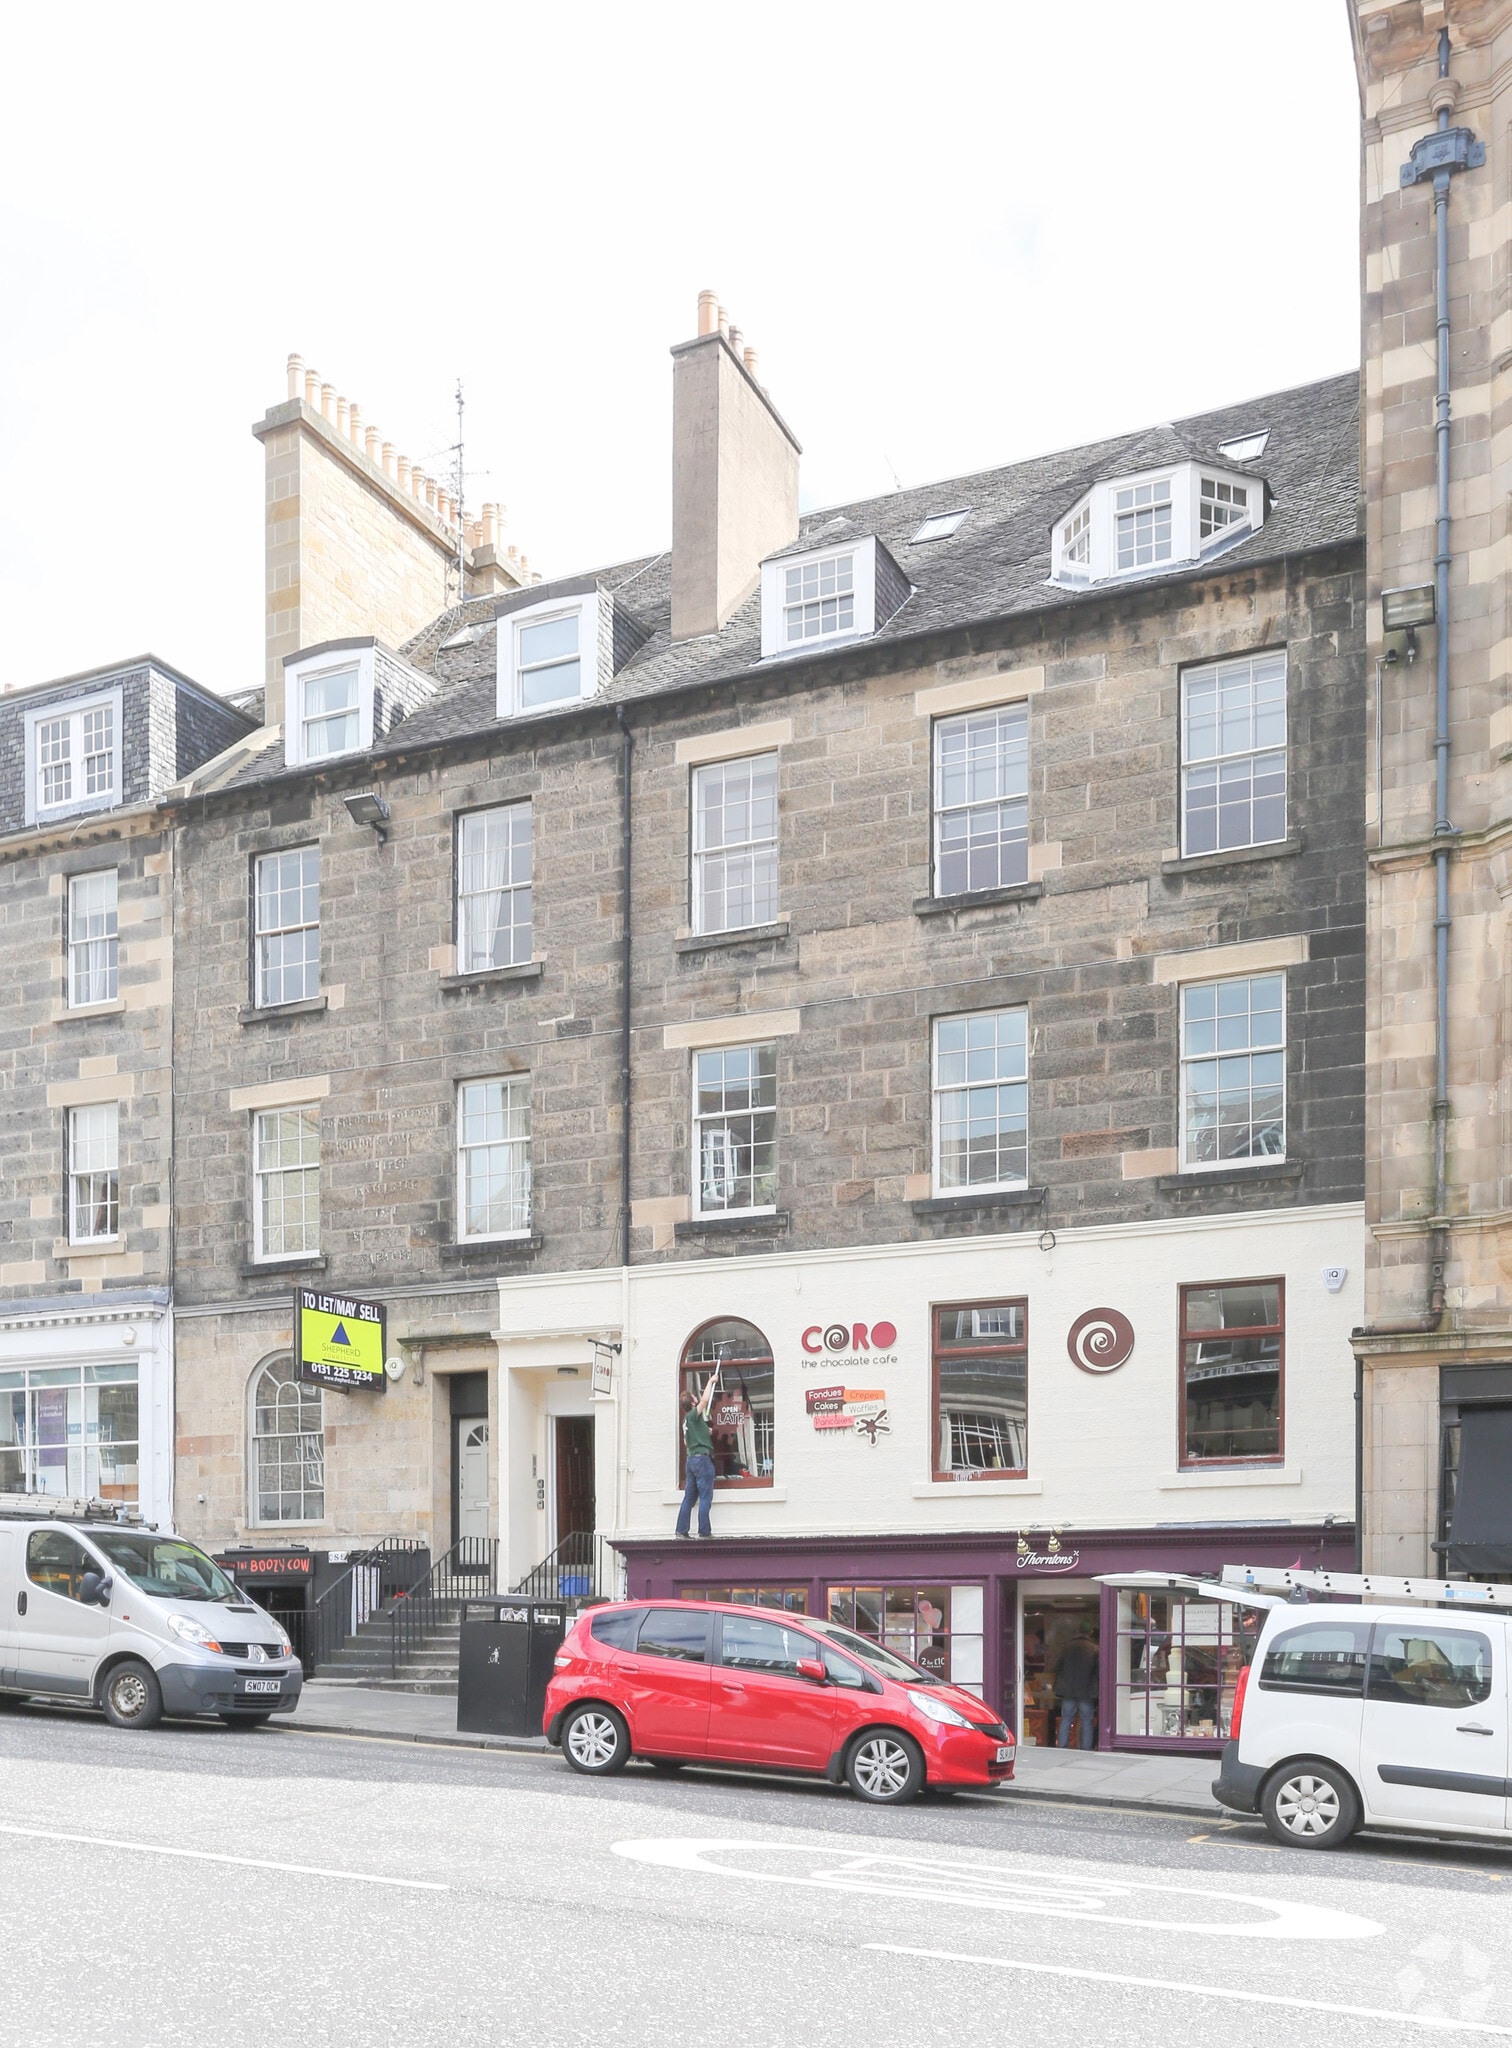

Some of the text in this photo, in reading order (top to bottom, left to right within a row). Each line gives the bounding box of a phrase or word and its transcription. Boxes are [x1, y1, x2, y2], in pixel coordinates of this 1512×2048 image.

[303, 1292, 380, 1322] TO LET/MAY SELL
[801, 1321, 897, 1353] CORO
[321, 1343, 361, 1357] SHEPHERD
[801, 1354, 898, 1369] the chocolate cafe
[311, 1363, 373, 1382] 0131 225 1234
[808, 1389, 842, 1400] Fondues
[721, 1405, 739, 1413] OPEN
[813, 1401, 839, 1411] Cakes
[849, 1404, 879, 1413] Waffles
[716, 1412, 745, 1425] LATE
[815, 1416, 853, 1426] Pancakes
[250, 1558, 285, 1573] BOOZY
[287, 1557, 310, 1573] COW
[1016, 1551, 1073, 1568] Thorntons
